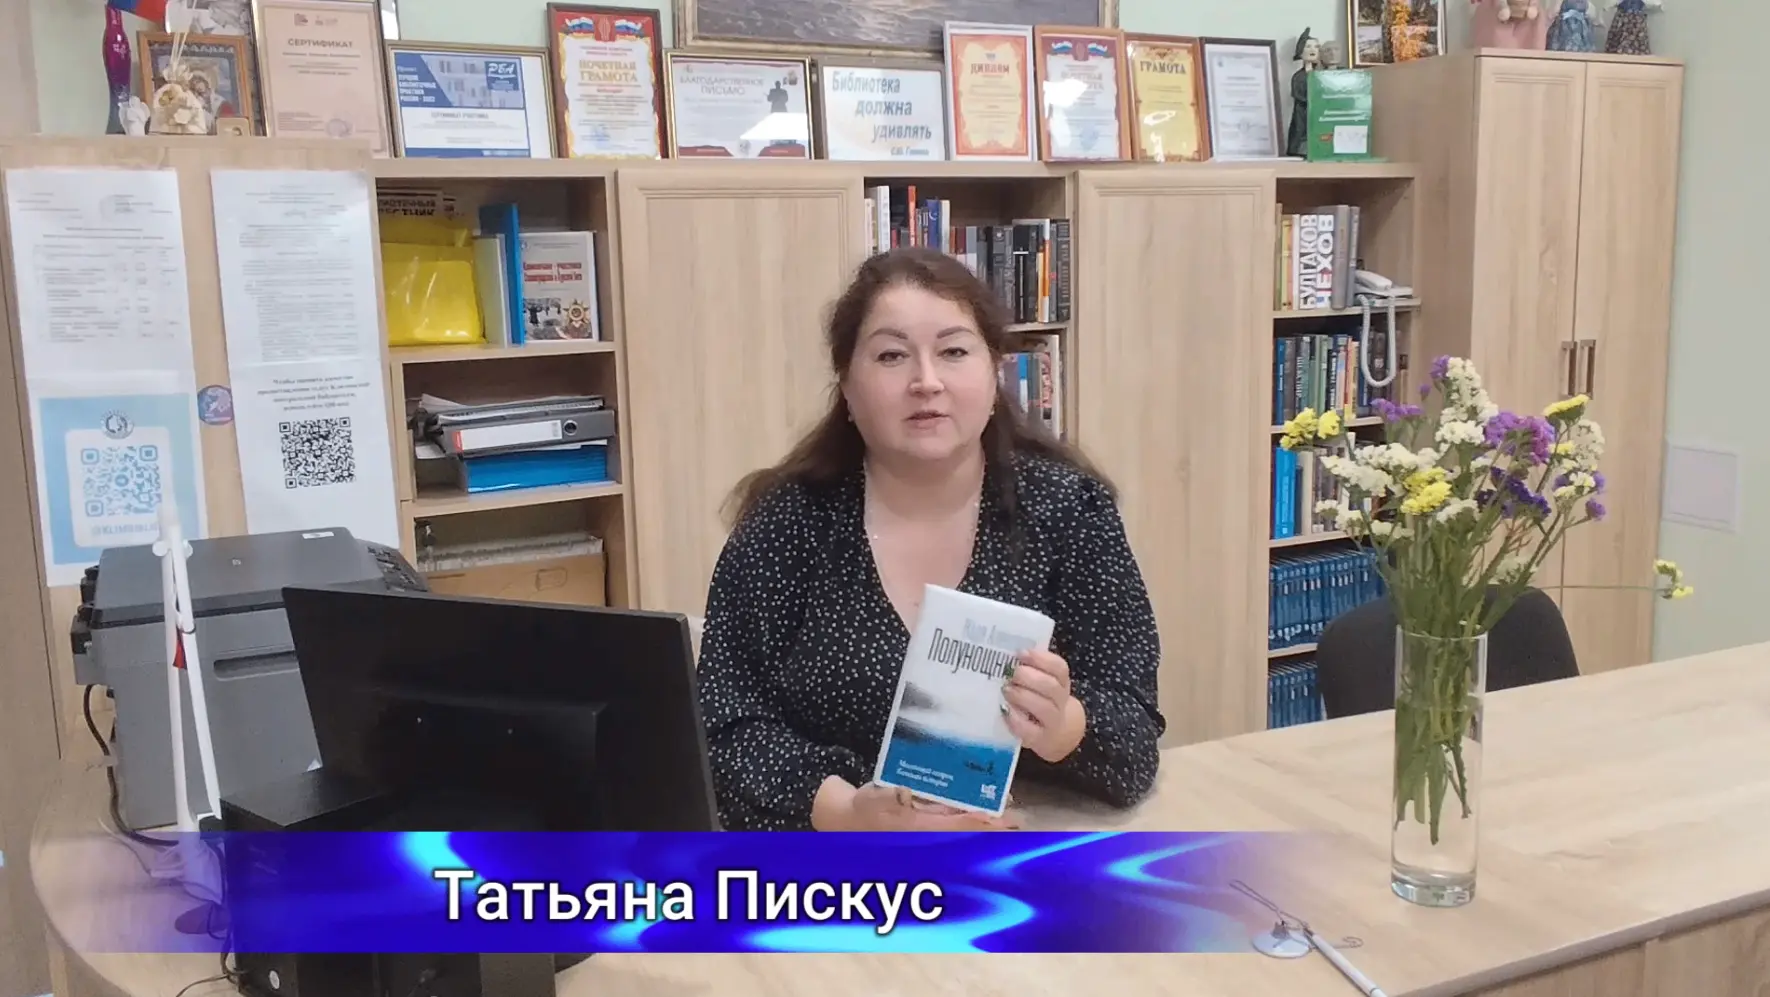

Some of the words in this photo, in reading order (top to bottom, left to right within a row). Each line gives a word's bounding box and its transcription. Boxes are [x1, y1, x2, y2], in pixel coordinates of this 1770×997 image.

[287, 37, 353, 48] СЕРТИФИКАТ
[488, 62, 515, 76] РБА
[579, 60, 636, 71] ПОЧЕТНАЯ
[970, 63, 1010, 75] ДИПЛОМ
[1139, 60, 1186, 74] ГРАМОТА
[580, 70, 638, 82] ГРАМОТА
[680, 75, 764, 87] БЛАГОДАРСТВЕННОЕ
[832, 70, 901, 94] Библиотека
[701, 85, 746, 96] ПИСЬМО
[855, 99, 912, 118] должна
[872, 123, 932, 143] удивлять
[1300, 214, 1317, 309] БУЛГАКОВ
[1317, 215, 1334, 307] ЧЕХОВ
